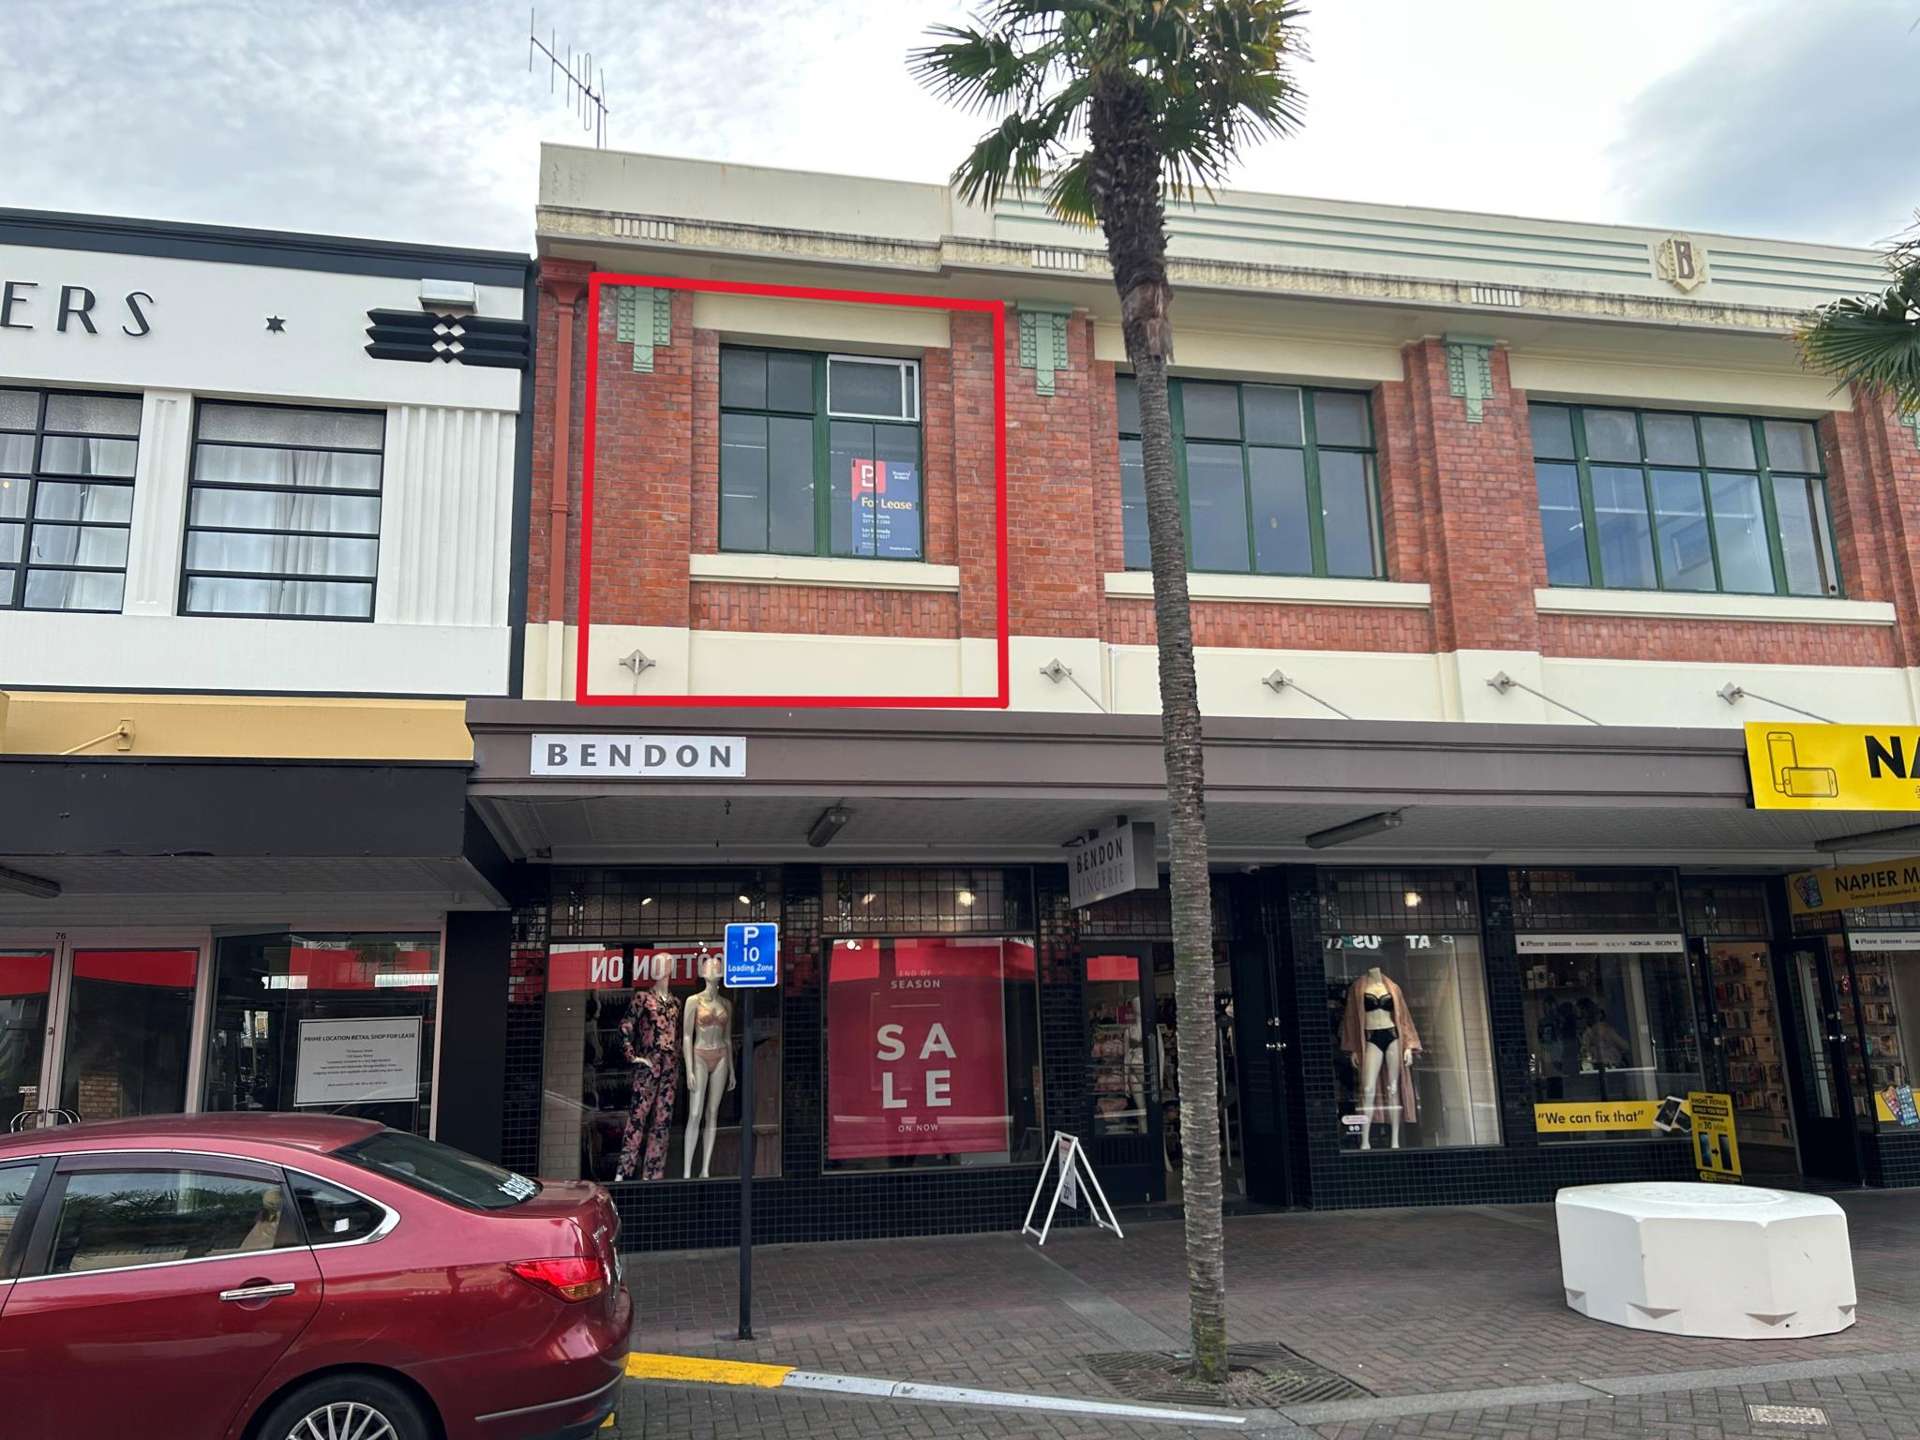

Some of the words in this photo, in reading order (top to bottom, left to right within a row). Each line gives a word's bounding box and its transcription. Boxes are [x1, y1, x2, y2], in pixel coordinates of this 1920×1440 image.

[1674, 240, 1695, 279] B
[0, 281, 154, 337] ERS
[881, 498, 912, 510] Lease
[547, 743, 731, 768] BENDON
[1076, 836, 1123, 874] BENDON
[1078, 863, 1124, 897] LINGERIE
[1835, 870, 1898, 893] NAPIER
[743, 926, 760, 946] P
[744, 947, 760, 962] 10
[728, 963, 755, 973] Loading
[756, 963, 774, 972] Zone
[890, 979, 941, 989] SEASON
[1569, 1113, 1591, 1124] can
[1595, 1110, 1610, 1123] fix
[898, 1125, 912, 1133] ON
[917, 1124, 938, 1132] NOW
